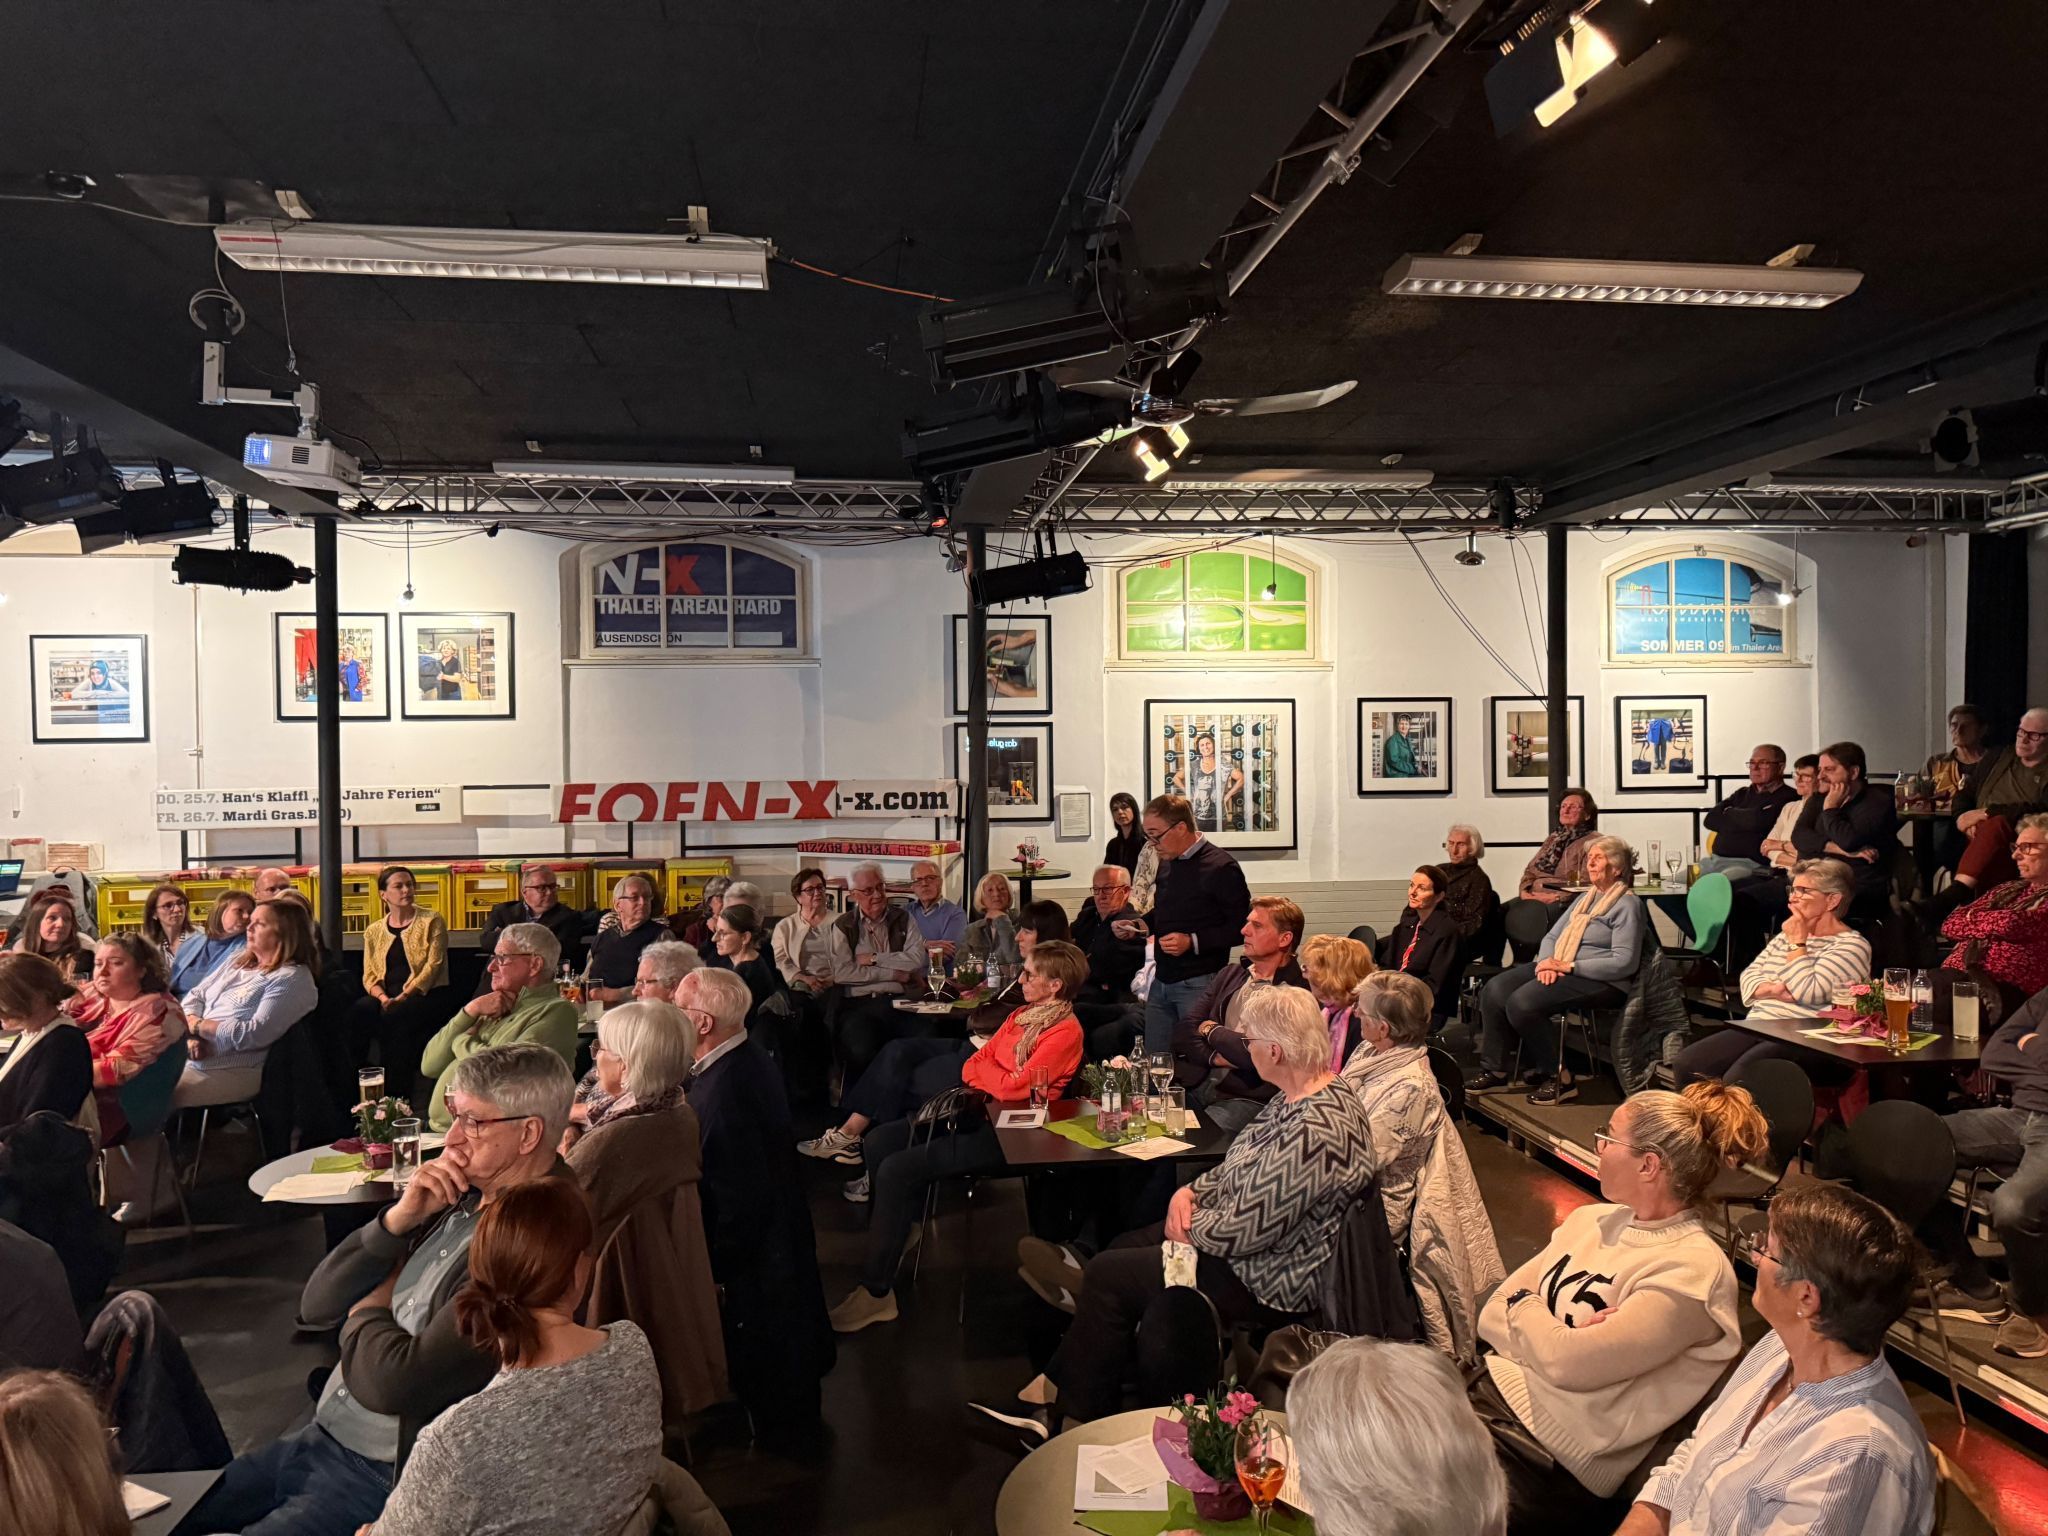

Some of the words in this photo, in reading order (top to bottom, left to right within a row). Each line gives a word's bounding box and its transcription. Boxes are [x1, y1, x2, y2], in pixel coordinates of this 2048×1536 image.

[671, 598, 728, 614] AREAL
[734, 599, 781, 615] HARD
[596, 633, 682, 643] AUSENDSCÖN
[156, 793, 180, 804] DO.
[184, 793, 219, 804] 25.7.
[267, 790, 309, 802] Klaffl
[342, 789, 384, 800] Jahre
[836, 789, 949, 811] -x.com
[157, 812, 180, 823] FR.
[184, 812, 219, 822] 26.7.
[222, 809, 267, 821] Mardi
